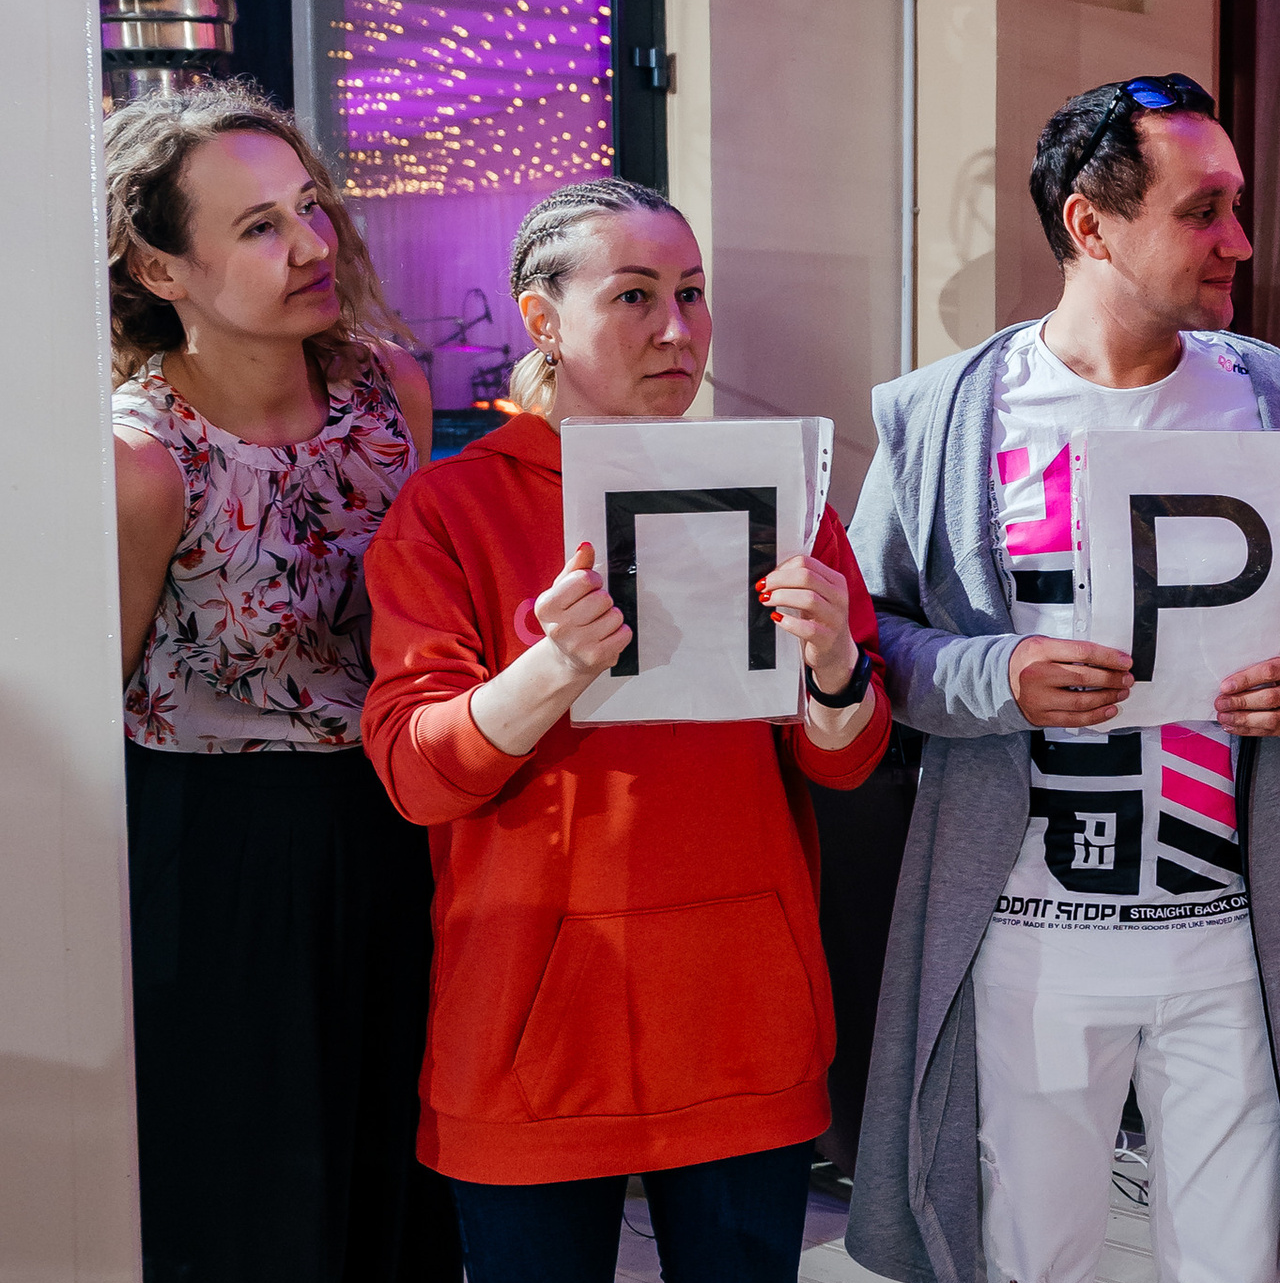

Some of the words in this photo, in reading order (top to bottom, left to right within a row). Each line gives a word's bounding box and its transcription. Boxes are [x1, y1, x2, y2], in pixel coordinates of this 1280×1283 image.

[605, 487, 777, 677] П
[1129, 494, 1273, 683] Р
[1055, 901, 1117, 921] STOP
[1130, 906, 1193, 919] STRAIGHT
[1194, 901, 1229, 916] BACK
[1022, 919, 1045, 929] MADE
[1048, 922, 1060, 930] BY
[1061, 922, 1072, 930] US
[1171, 922, 1187, 930] FOR
[1187, 920, 1205, 929] LIKE
[1205, 916, 1233, 926] MINDED
